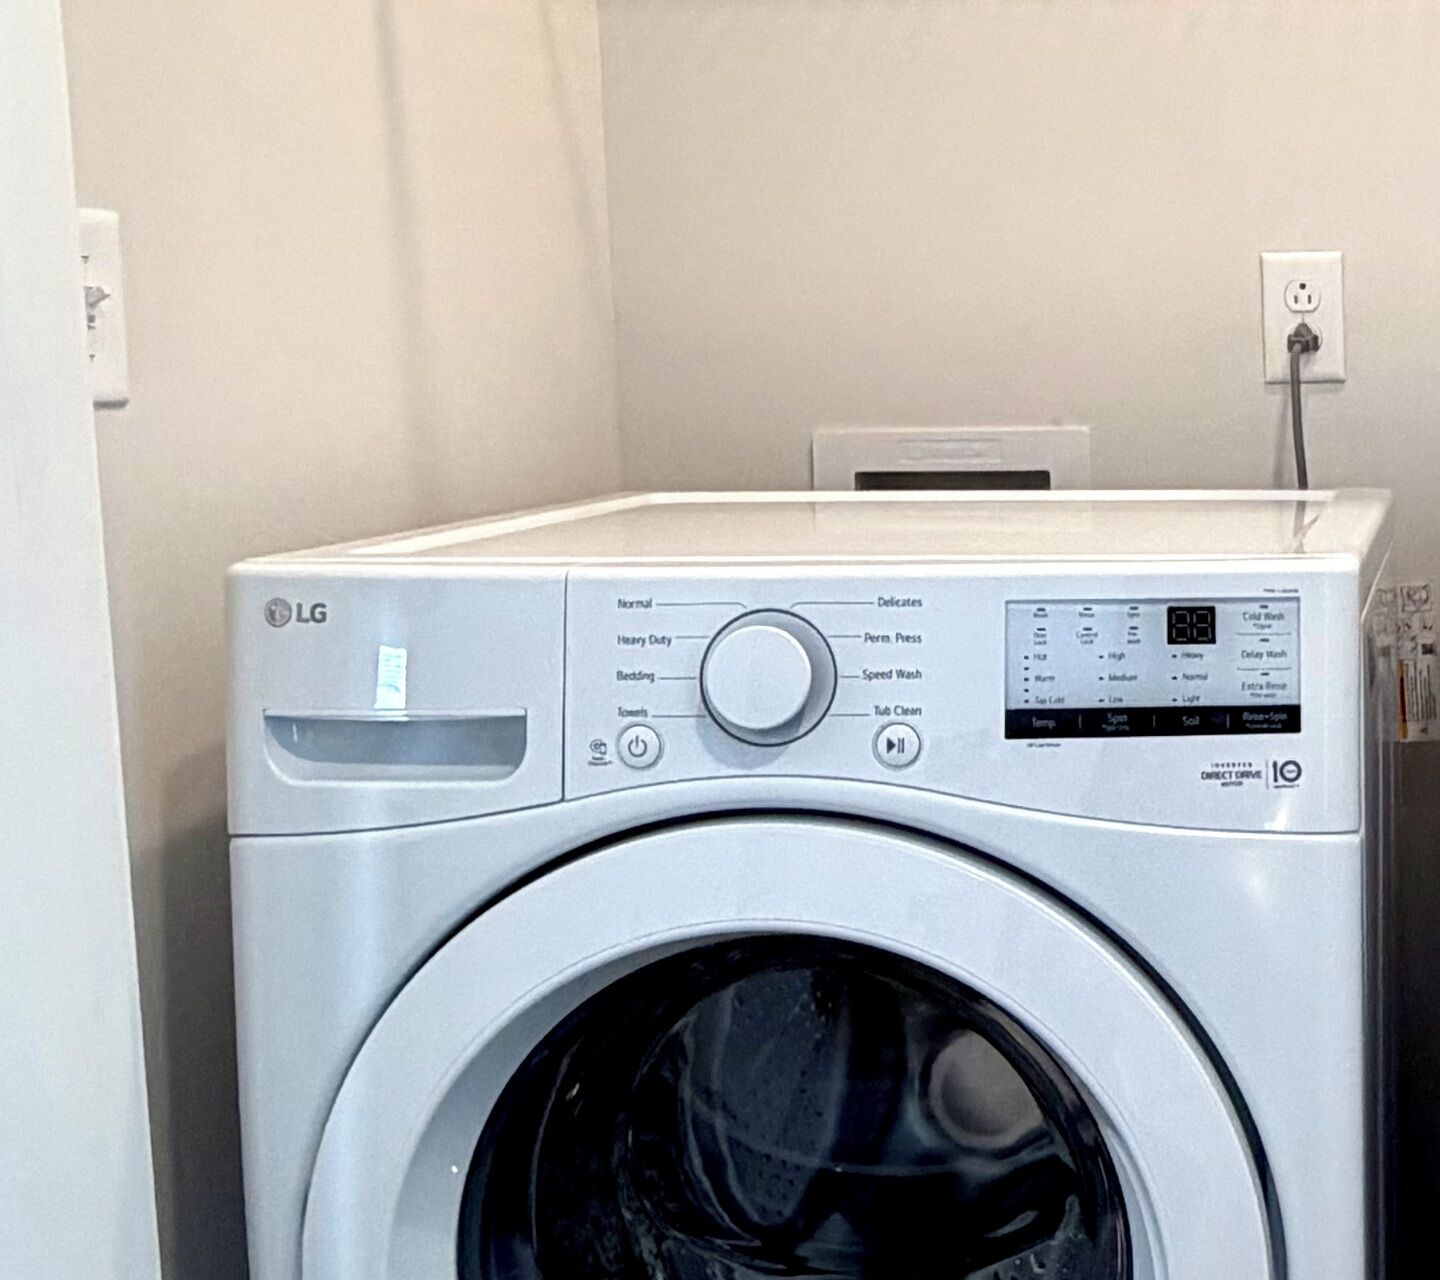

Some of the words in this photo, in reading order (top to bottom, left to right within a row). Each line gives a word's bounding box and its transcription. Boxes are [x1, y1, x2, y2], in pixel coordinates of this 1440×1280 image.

[617, 598, 653, 609] Normal
[877, 596, 923, 608] Delicates
[296, 602, 327, 623] LG
[617, 635, 646, 647] Heavy
[649, 635, 672, 647] Duty
[895, 632, 922, 643] Press
[616, 670, 655, 683] Bedding
[862, 668, 893, 681] Speed
[895, 668, 922, 679] Wash
[618, 707, 648, 718] Towels
[874, 705, 891, 716] Tub
[893, 705, 922, 716] Clean
